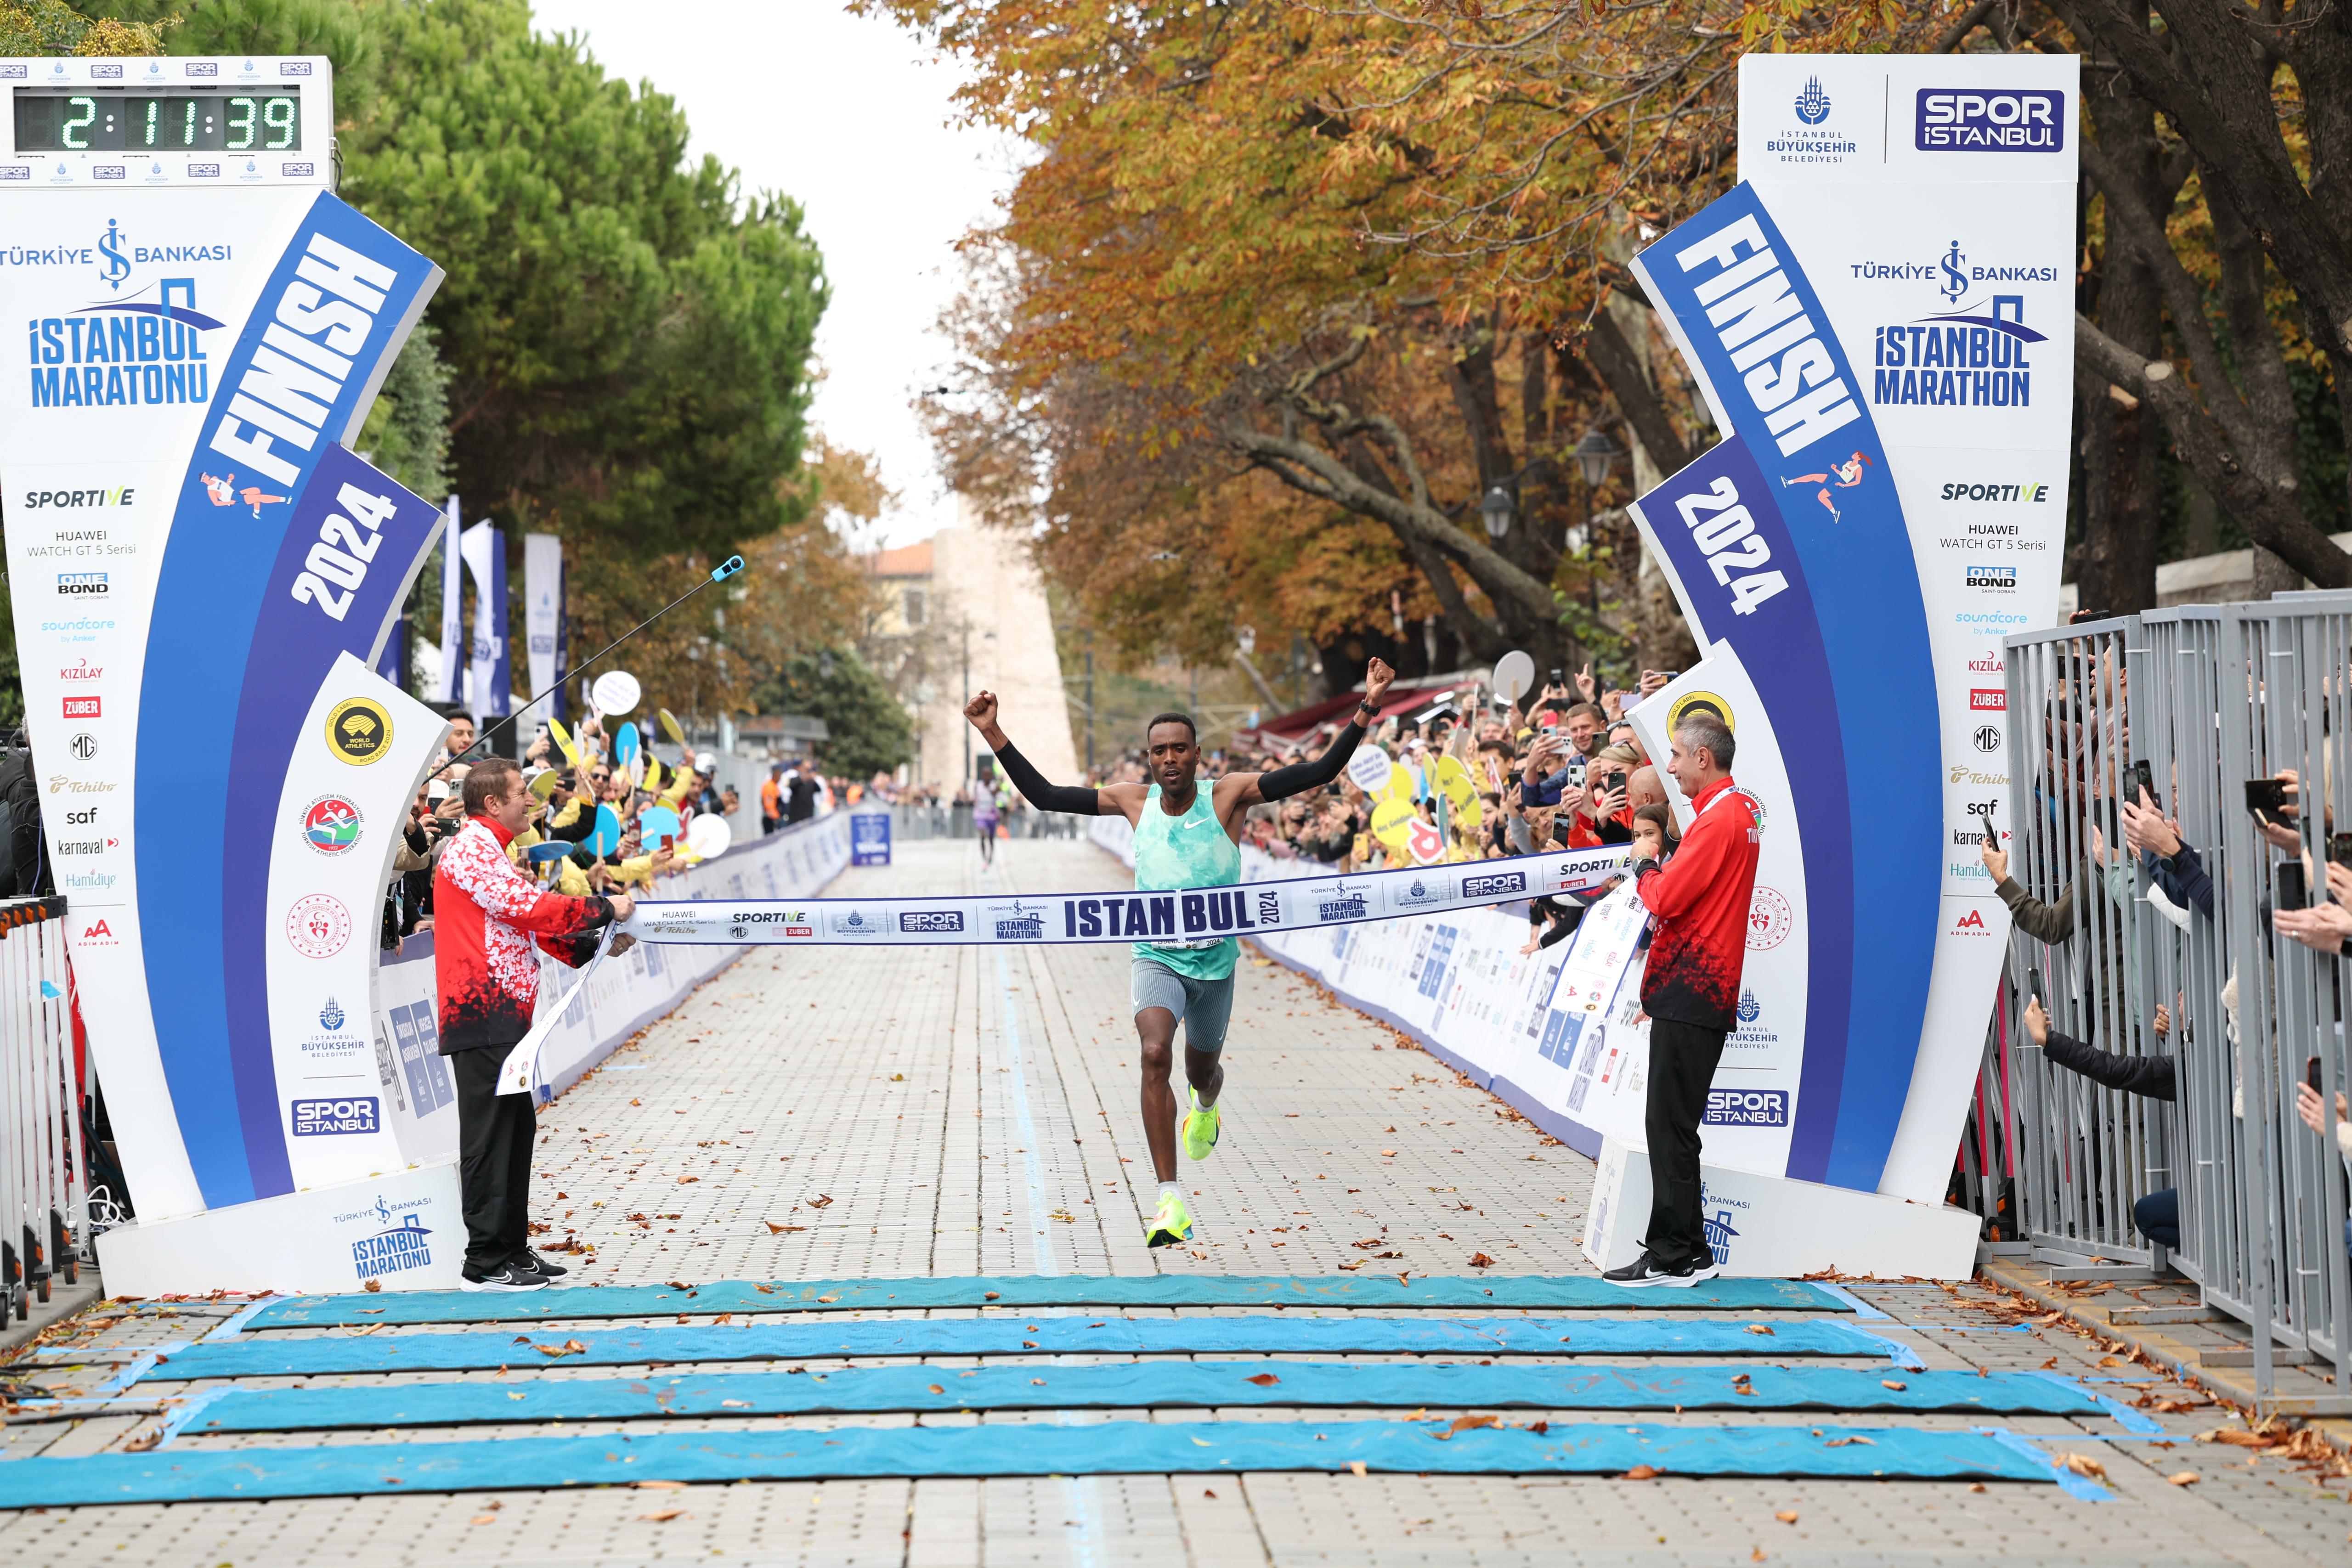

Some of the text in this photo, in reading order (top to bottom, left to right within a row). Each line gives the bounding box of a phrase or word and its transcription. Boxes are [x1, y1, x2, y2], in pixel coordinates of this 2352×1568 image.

[1925, 95, 2054, 125] SPOR
[1781, 129, 1843, 138] İSTANBUL
[1767, 140, 1856, 154] BÜYÜKŞEHİR
[1781, 154, 1843, 163] BELEDİYESİ
[0, 245, 93, 265] TÜRKİYE
[135, 245, 231, 263] BANKASI
[1850, 261, 1936, 280] TÜRKİYE
[1972, 267, 2057, 282] BANKASI
[1675, 213, 1861, 457] FINISH
[209, 232, 397, 488] FINISH
[32, 364, 208, 407] MARATONU
[1874, 369, 2030, 407] MARATHON
[24, 485, 135, 508] SPORTIVE
[1940, 482, 2049, 502] SPORTIVE
[56, 530, 107, 541] HUAWEI
[1968, 525, 2018, 535] HUAWEI
[27, 544, 136, 557] WATCH GT 5 Serisi
[291, 482, 397, 622] 2024
[1674, 476, 1789, 616] 2024
[1940, 538, 2046, 551] WATCH GT 5 Serisi
[60, 574, 106, 584] ONE
[1970, 568, 2013, 577] ONE
[58, 584, 108, 594] BOND
[1966, 577, 2016, 587] BOND
[41, 617, 115, 631] soundcore
[1955, 611, 2028, 624] soundcore
[61, 668, 103, 679] KIZILAY
[65, 700, 98, 715] ZÜBER
[1671, 694, 1696, 719] GOLD LABEL
[1973, 694, 2004, 707] ZÜBER
[328, 701, 353, 728] GOLD LABEL
[72, 737, 94, 758] MG
[1976, 728, 1998, 750] MG
[359, 753, 375, 763] ROAD
[375, 744, 387, 757] RACE
[68, 782, 117, 793] Tchibo
[299, 793, 365, 824] TÜRKİYE ATLETİZM FEDERASYONU
[1741, 787, 1768, 818] FEDERASYONU
[1967, 799, 1998, 815] saf
[67, 807, 97, 824] saf
[58, 838, 103, 855] karnaval
[301, 830, 363, 857] TURKISH ATHLETIC FEDERATION
[1560, 856, 1630, 876] SPORTIVE
[65, 873, 116, 890] Hamidiye
[1466, 875, 1521, 891] SPOR
[1259, 891, 1279, 924] 2024
[1628, 896, 1639, 910] BOND
[732, 910, 806, 923] SPORTIVE
[903, 913, 960, 925] SPOR
[1064, 891, 1255, 937] ISTANBUL
[1320, 910, 1366, 921] MARATHON
[997, 931, 1042, 939] MARATONU
[1206, 938, 1220, 947] 2024
[301, 1040, 364, 1051] BÜYÜKŞEHİR
[1707, 1092, 1783, 1111] SPOR
[296, 1101, 374, 1121] SPOR
[333, 1197, 432, 1223] TÜRKİYE BANKASI
[1709, 1196, 1750, 1209] BANKASI
[356, 1248, 431, 1279] MARATONU
